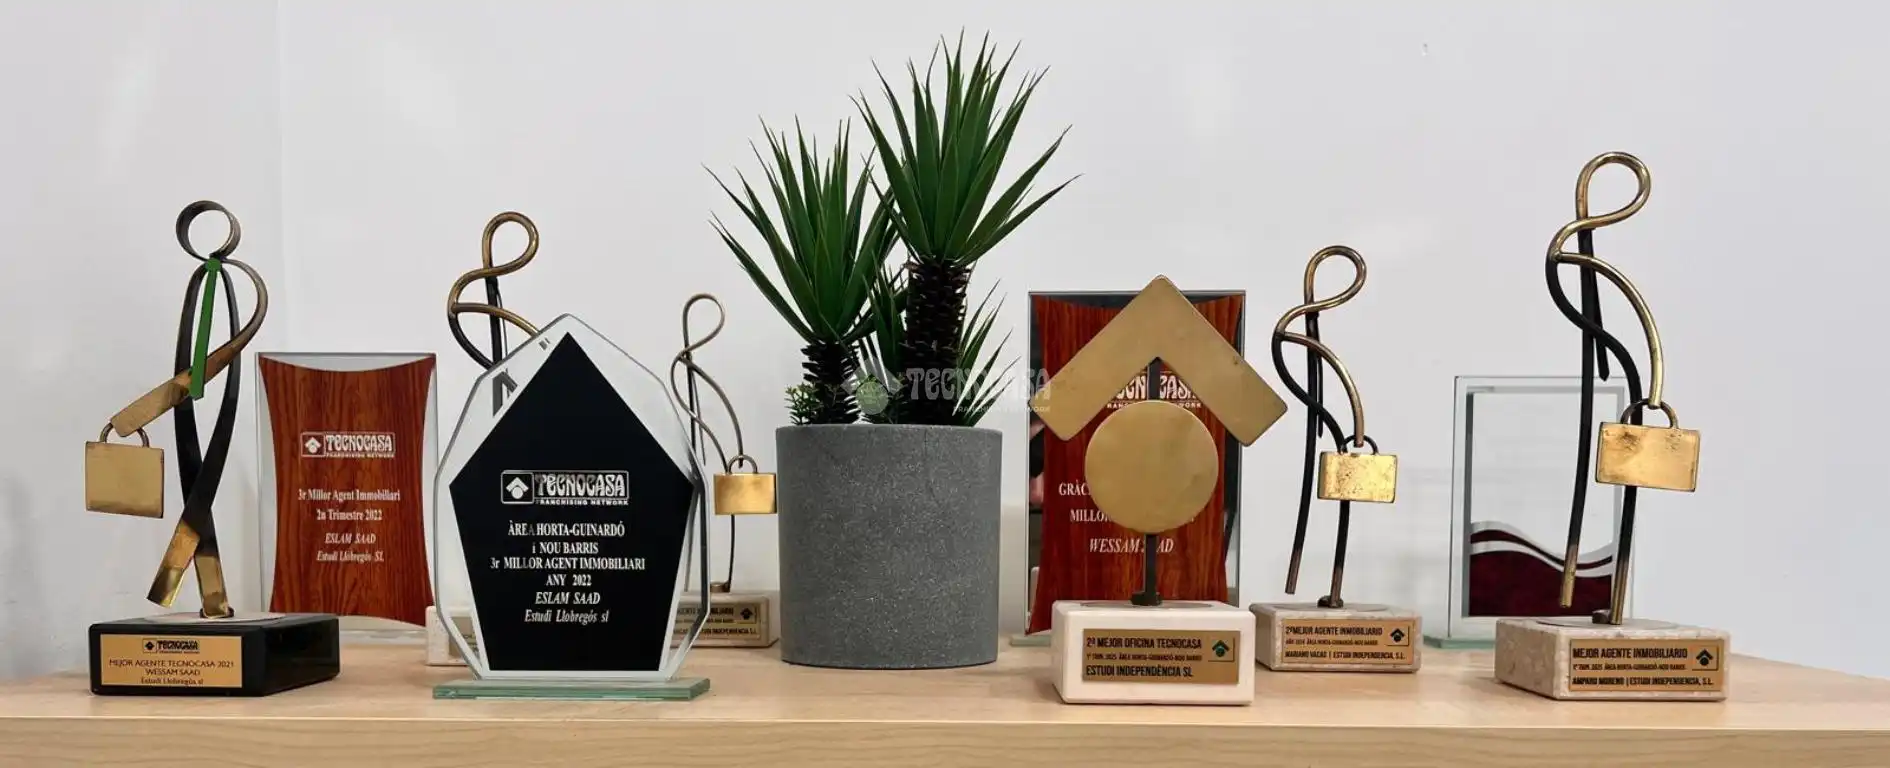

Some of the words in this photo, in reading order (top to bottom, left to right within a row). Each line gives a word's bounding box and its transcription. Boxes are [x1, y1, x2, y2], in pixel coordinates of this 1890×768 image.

[325, 434, 393, 452] TECNOCASA
[535, 474, 626, 497] TECNOCASA
[308, 489, 331, 501] Millor
[333, 490, 355, 503] Agent
[327, 508, 363, 521] Trimestre
[365, 508, 383, 521] 2022
[508, 520, 535, 537] ÀREA
[536, 521, 626, 537] HORTA-GUINARDÓ
[325, 532, 352, 544] ESLAM
[354, 532, 377, 544] SAAD
[539, 542, 562, 554] NOU
[563, 542, 599, 554] BARRIS
[1089, 538, 1140, 553] WESSAM
[490, 557, 500, 569] 3r
[504, 556, 543, 570] MILLOR
[544, 557, 579, 570] AGENT
[579, 557, 646, 570] IMMOBILIARI
[546, 574, 567, 587] ANY
[572, 574, 593, 587] 2022
[534, 591, 570, 605] ESLAM
[573, 591, 601, 605] SAAD
[524, 609, 552, 623] Estudi
[555, 609, 598, 626] Llobregós
[1314, 626, 1338, 635] AGENTE
[1339, 626, 1383, 636] INMOBILIARIO
[1097, 638, 1123, 648] MEJOR
[1124, 638, 1155, 649] OFICINA
[1156, 639, 1202, 650] TECNOCASA
[1572, 648, 1599, 658] MEJOR
[1600, 648, 1632, 658] AGENTE
[1633, 648, 1688, 658] INMOBILIARIO
[109, 659, 133, 667] MEJOR
[135, 659, 165, 667] AGENTE
[145, 668, 178, 676] WESSAM
[1086, 665, 1115, 676] ESTUDI
[1598, 677, 1625, 685] MORENO
[1629, 677, 1650, 685] ESTUDI
